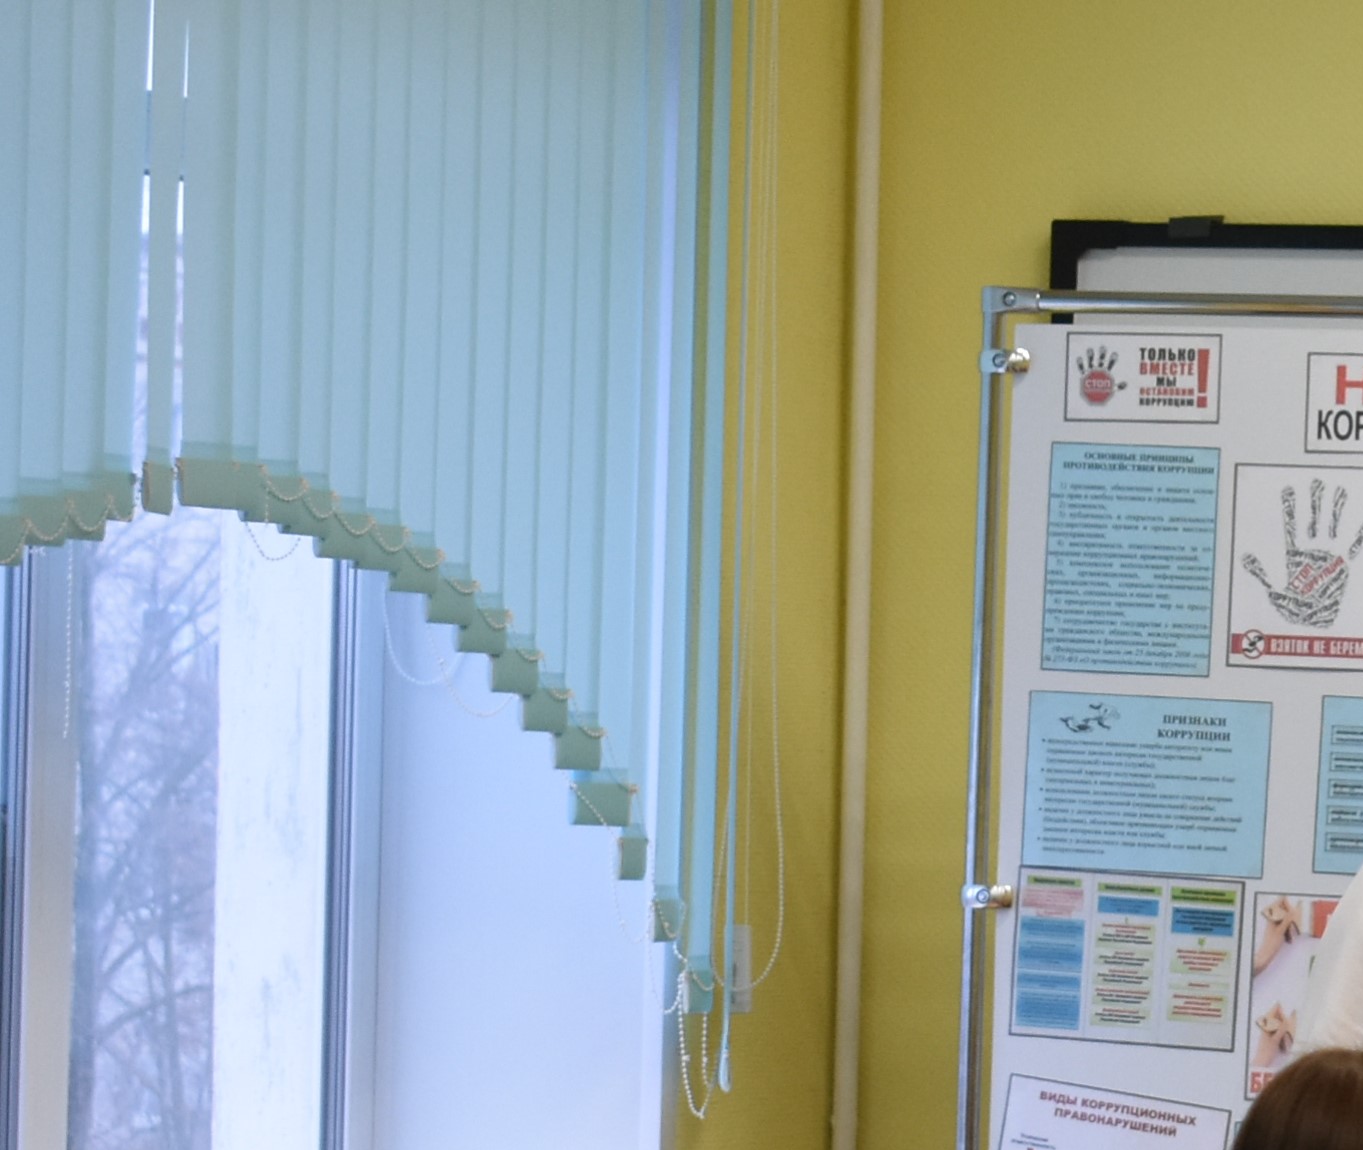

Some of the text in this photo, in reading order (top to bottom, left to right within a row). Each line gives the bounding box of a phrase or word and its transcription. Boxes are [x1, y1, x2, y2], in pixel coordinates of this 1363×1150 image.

[1139, 348, 1196, 361] ТОЛЬКО
[1139, 363, 1194, 376] ВМЕСТЕ
[1156, 377, 1177, 387] МЫ
[1291, 562, 1313, 589] СТОП
[1270, 638, 1309, 653] ВЗЯТОК
[1313, 639, 1326, 653] НЕ
[1162, 714, 1228, 727] ПРИЗНАКИ
[1157, 728, 1231, 742] КОРРУПЦИИ
[1039, 1091, 1197, 1126] ВИДЫ КОРРУПЦИОННЫХ
[1054, 1107, 1177, 1137] ПРАВОНАРУШЕНИЙ
